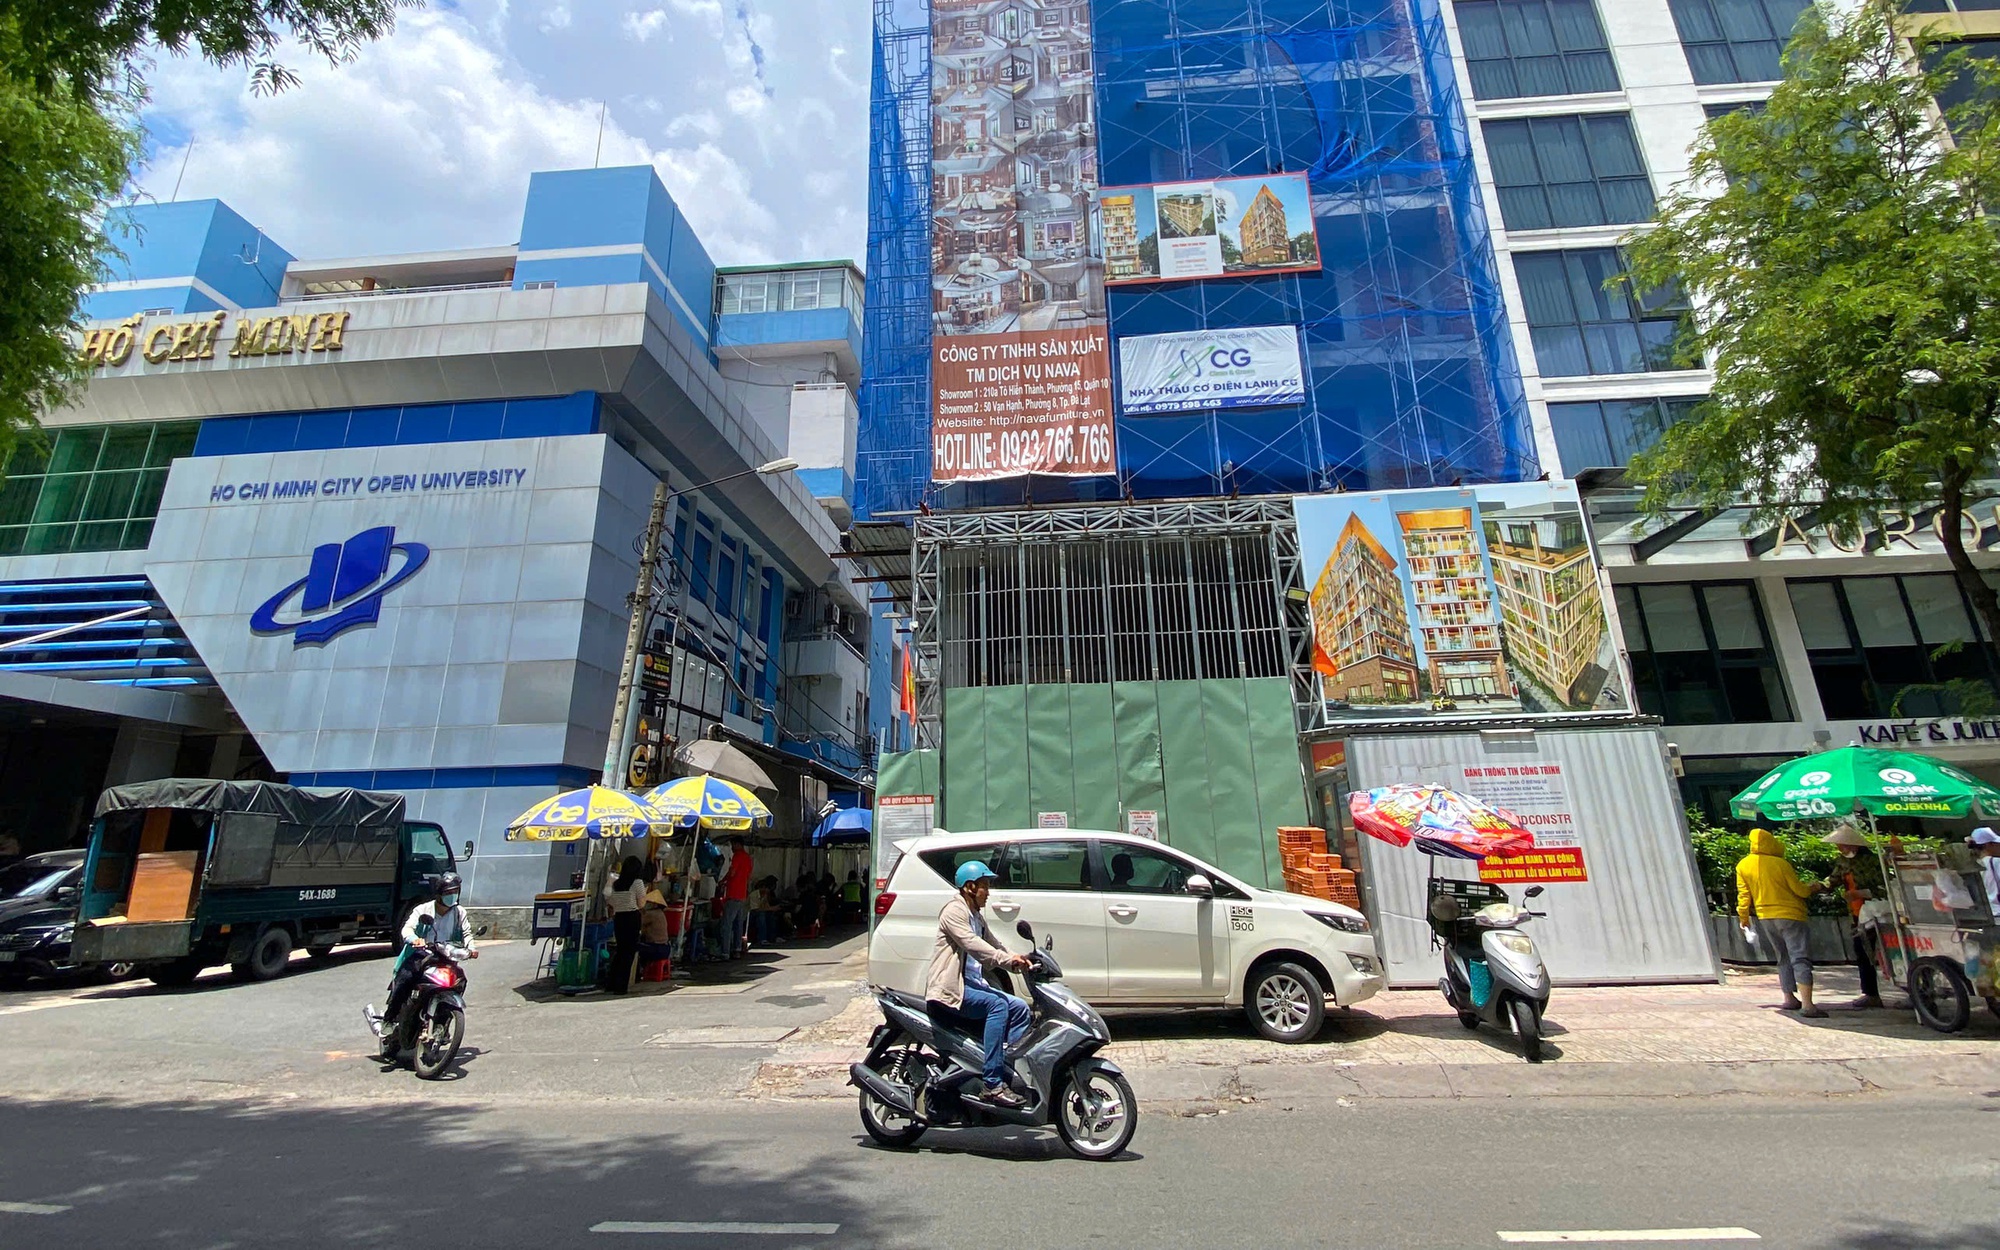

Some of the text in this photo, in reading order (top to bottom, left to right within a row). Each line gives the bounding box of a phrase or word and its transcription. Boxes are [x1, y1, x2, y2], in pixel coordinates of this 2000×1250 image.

[229, 312, 350, 357] MINH
[940, 344, 978, 362] CÔNG
[981, 345, 998, 360] TY
[1001, 342, 1036, 359] TNHH
[1210, 348, 1251, 368] CG
[966, 362, 1080, 384] TM DỊCH VỤ NAVA
[940, 389, 973, 400] Showroom
[983, 387, 998, 398] 210a
[1100, 378, 1109, 389] 10
[1129, 387, 1155, 397] NHÀ
[1245, 380, 1278, 390] LẠNH
[1281, 379, 1298, 387] CG
[940, 404, 973, 415] Showroom
[974, 402, 979, 413] 2
[983, 401, 992, 412] 50
[1059, 397, 1069, 409] Tp.
[1154, 402, 1180, 410] 0979
[1182, 401, 1200, 409] 598
[990, 409, 1105, 427] http://navafurniture.vn
[935, 432, 996, 471] HOTLINE:
[210, 468, 527, 502] HO CHI MINH CITY OPEN UNIVERSITY
[1859, 719, 1921, 743] KAFÉ
[1928, 723, 1948, 740] &
[1507, 767, 1519, 776] TIN
[1882, 784, 1939, 796] gojek
[706, 792, 741, 814] be
[1885, 803, 1951, 811] GOJEKNHA
[545, 802, 585, 823] be
[1516, 814, 1572, 825] DCONSTR
[560, 828, 572, 837] XE
[600, 823, 634, 838] 50K
[1485, 854, 1503, 865] CÔNG
[1544, 854, 1556, 864] THI
[1557, 853, 1575, 863] CÔNG
[1514, 869, 1526, 877] XIN
[299, 889, 336, 900] 54X-1688
[1231, 921, 1254, 931] 1900
